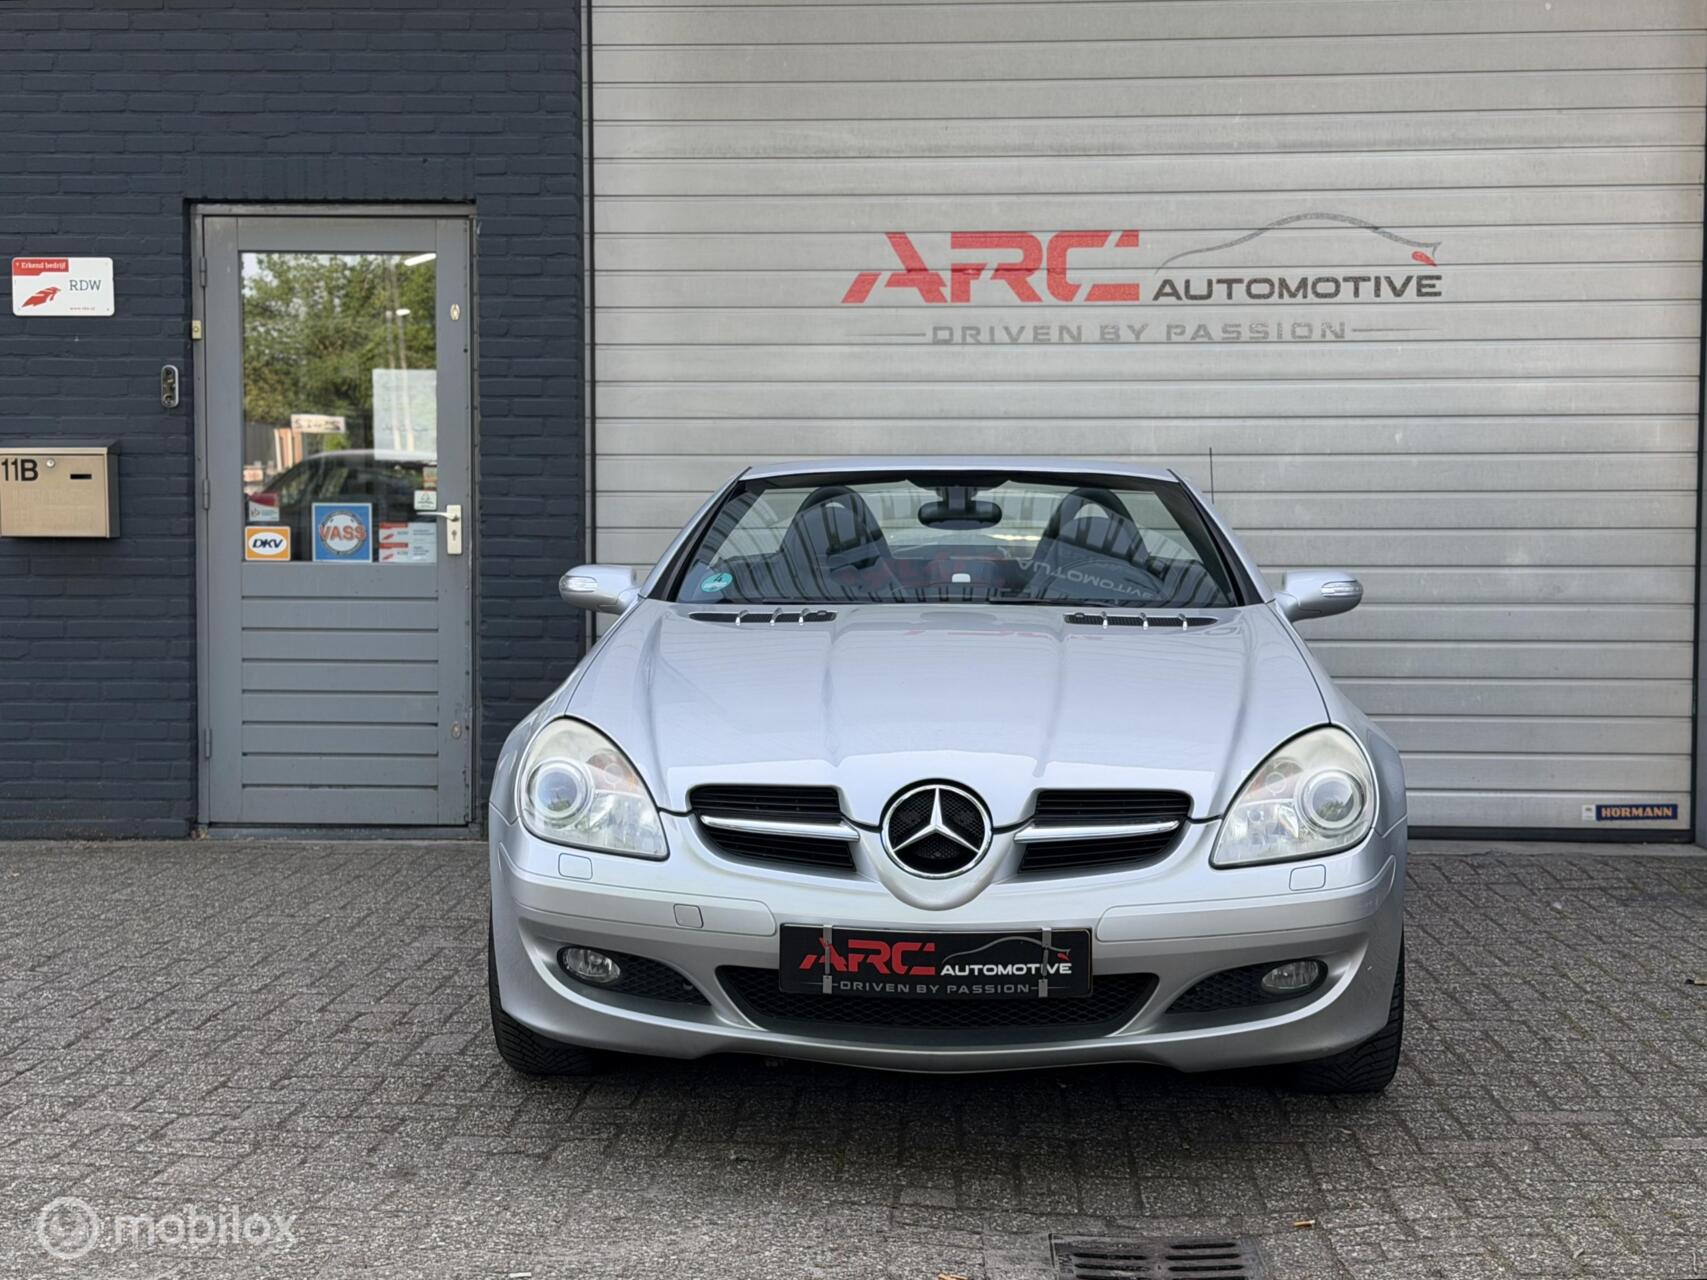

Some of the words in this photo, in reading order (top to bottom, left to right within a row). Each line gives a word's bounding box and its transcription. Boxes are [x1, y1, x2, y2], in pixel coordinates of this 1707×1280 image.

[841, 230, 1140, 304] ARC
[1152, 274, 1443, 302] AUTOMOTIVE
[69, 279, 102, 292] RDW
[932, 324, 1082, 344] DRIVEN
[1099, 323, 1149, 343] BY
[1166, 321, 1346, 342] PASSION
[1, 458, 39, 481] 11B
[252, 538, 284, 549] DKV
[799, 936, 936, 976] ARC
[840, 981, 910, 993] DRIVEN
[916, 984, 940, 994] BY
[946, 983, 1029, 994] PASSION
